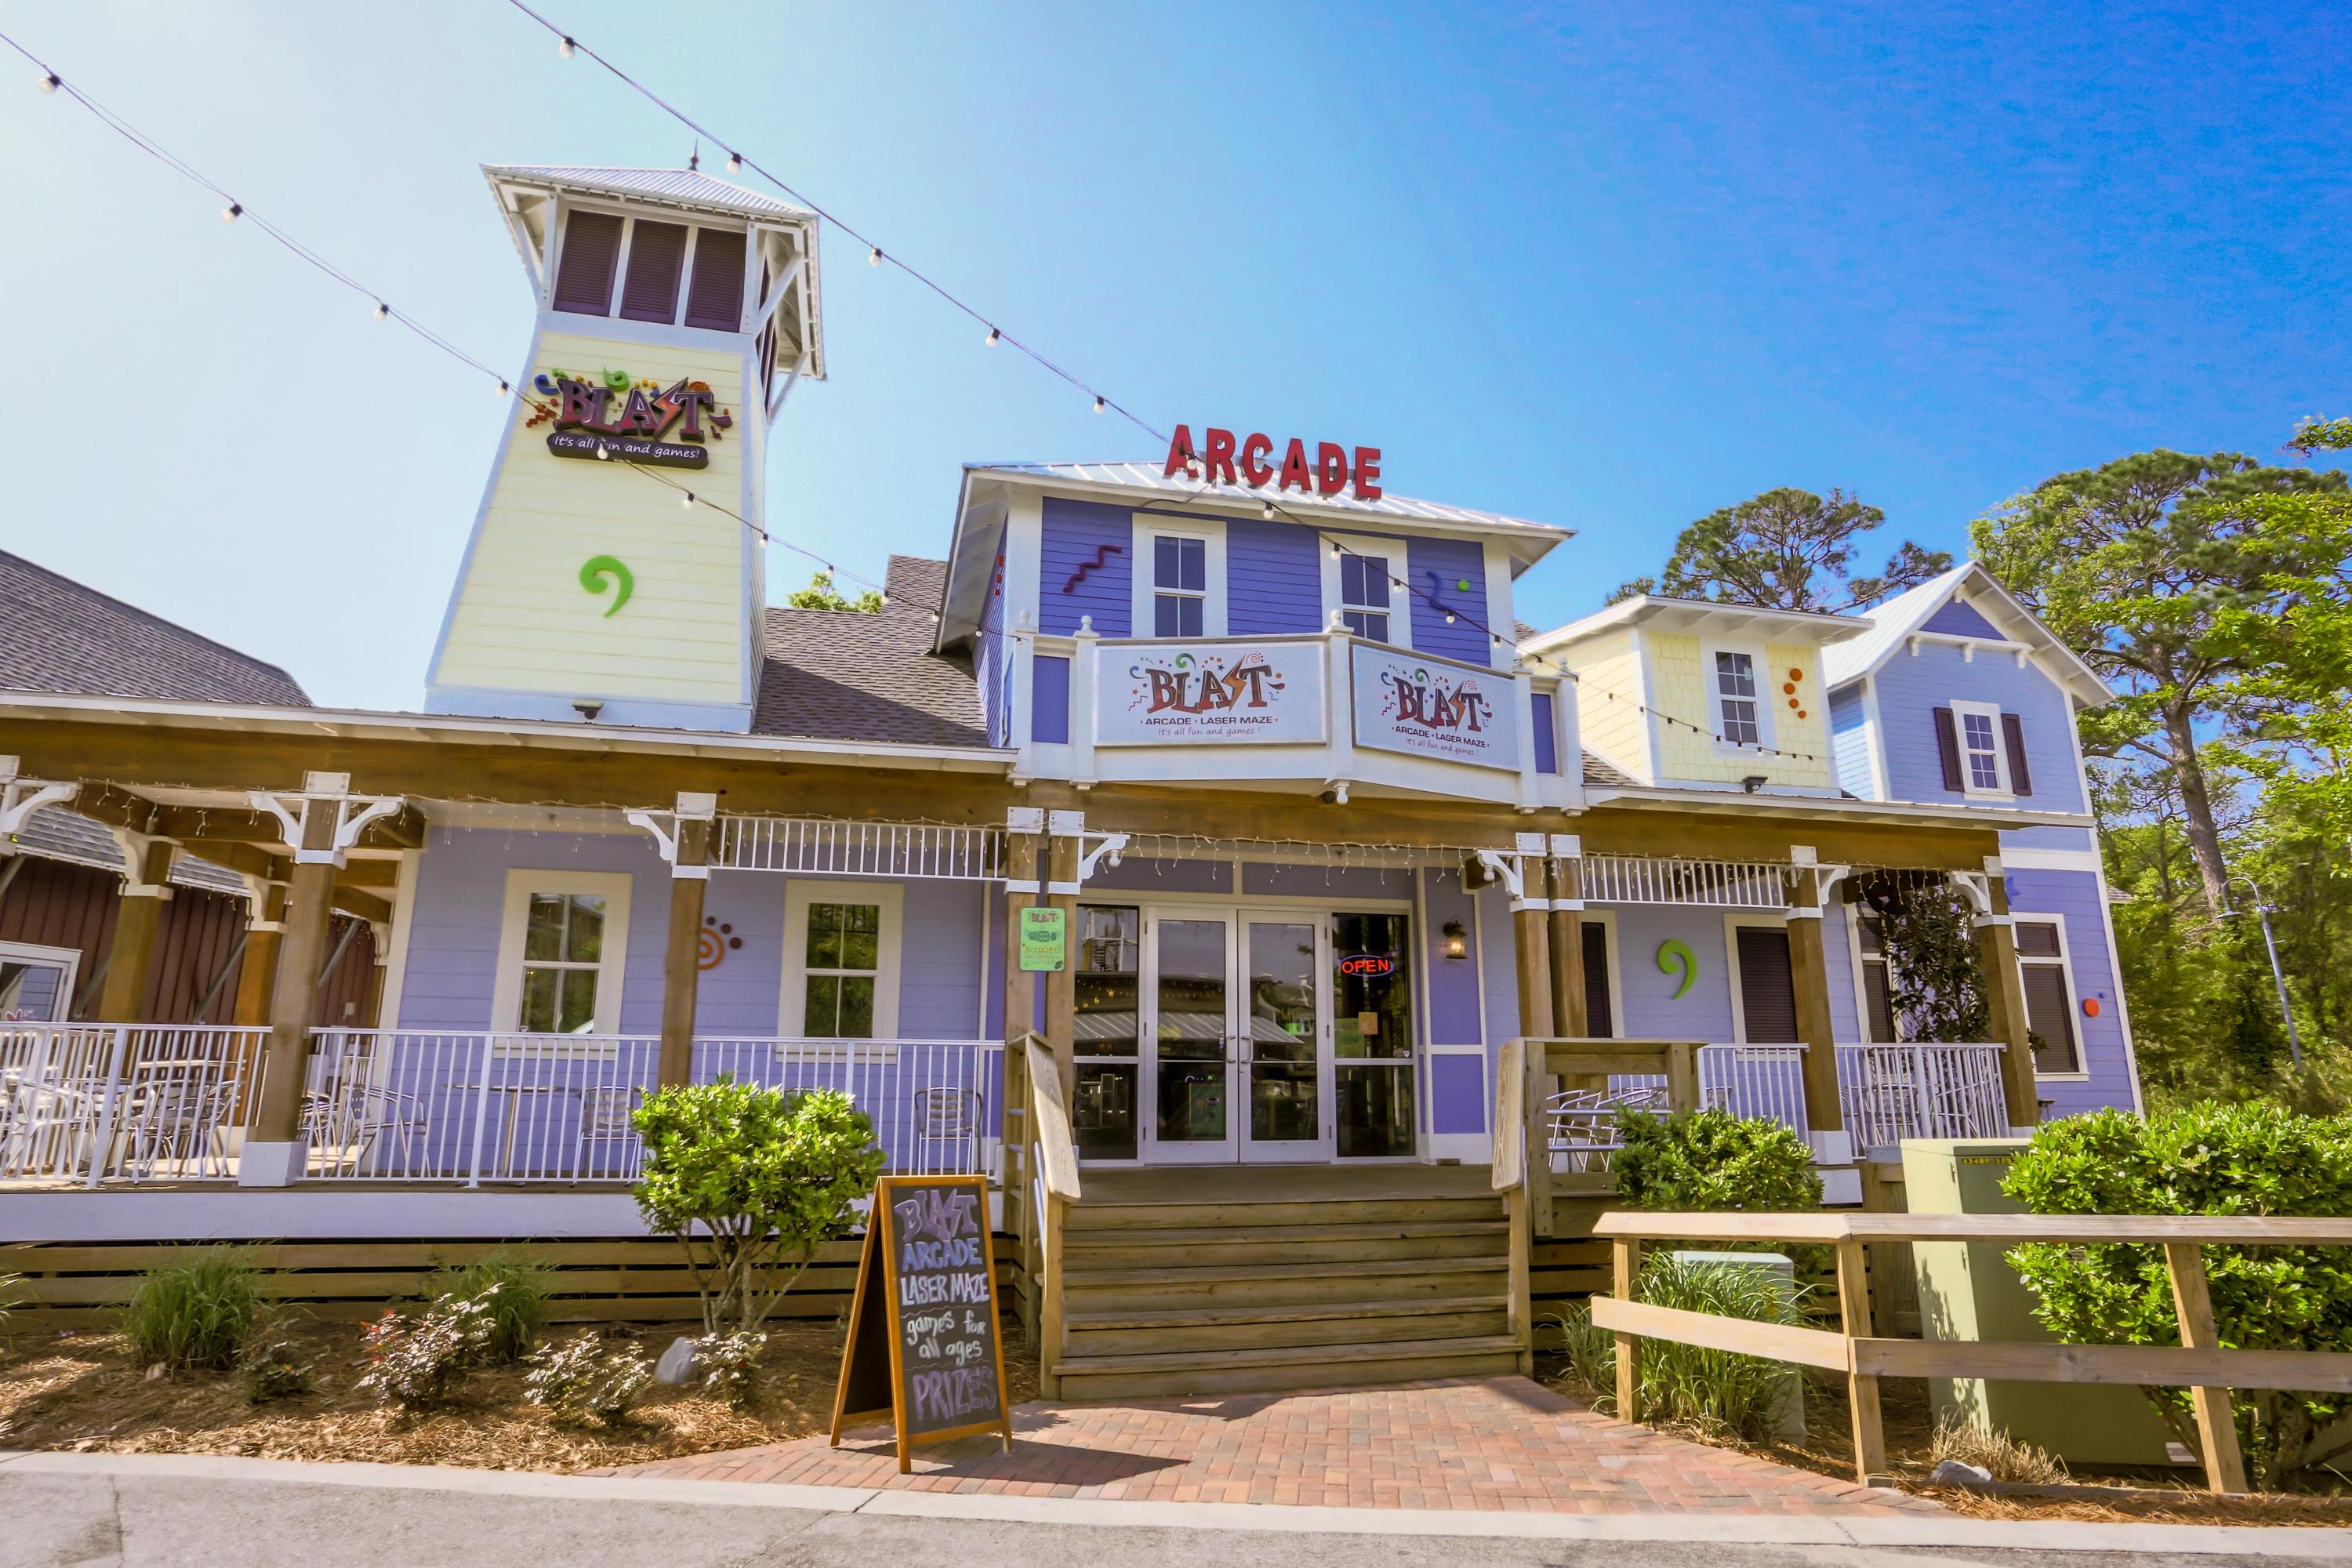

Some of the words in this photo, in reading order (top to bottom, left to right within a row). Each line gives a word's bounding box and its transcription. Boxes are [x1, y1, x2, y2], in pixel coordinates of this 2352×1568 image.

[553, 376, 715, 443] BLAST
[554, 436, 573, 447] It's
[578, 438, 593, 448] all
[625, 441, 651, 454] and
[655, 448, 700, 459] games!
[1163, 424, 1382, 499] ARCADE
[1145, 655, 1272, 714] BLAST
[1392, 676, 1483, 732] BLAST
[1396, 725, 1429, 738] ARCADE
[1436, 733, 1461, 744] LASER
[1464, 738, 1486, 748] MAZE
[1428, 740, 1438, 749] fun
[1341, 959, 1389, 974] OPEN
[894, 1189, 978, 1242] BLAST
[902, 1239, 982, 1272] ARCADE
[901, 1275, 949, 1306] LASER
[949, 1272, 990, 1303] MAZE
[907, 1310, 955, 1345] games
[919, 1337, 939, 1359] all
[945, 1341, 983, 1366] ages
[913, 1367, 996, 1420] PRIZES
